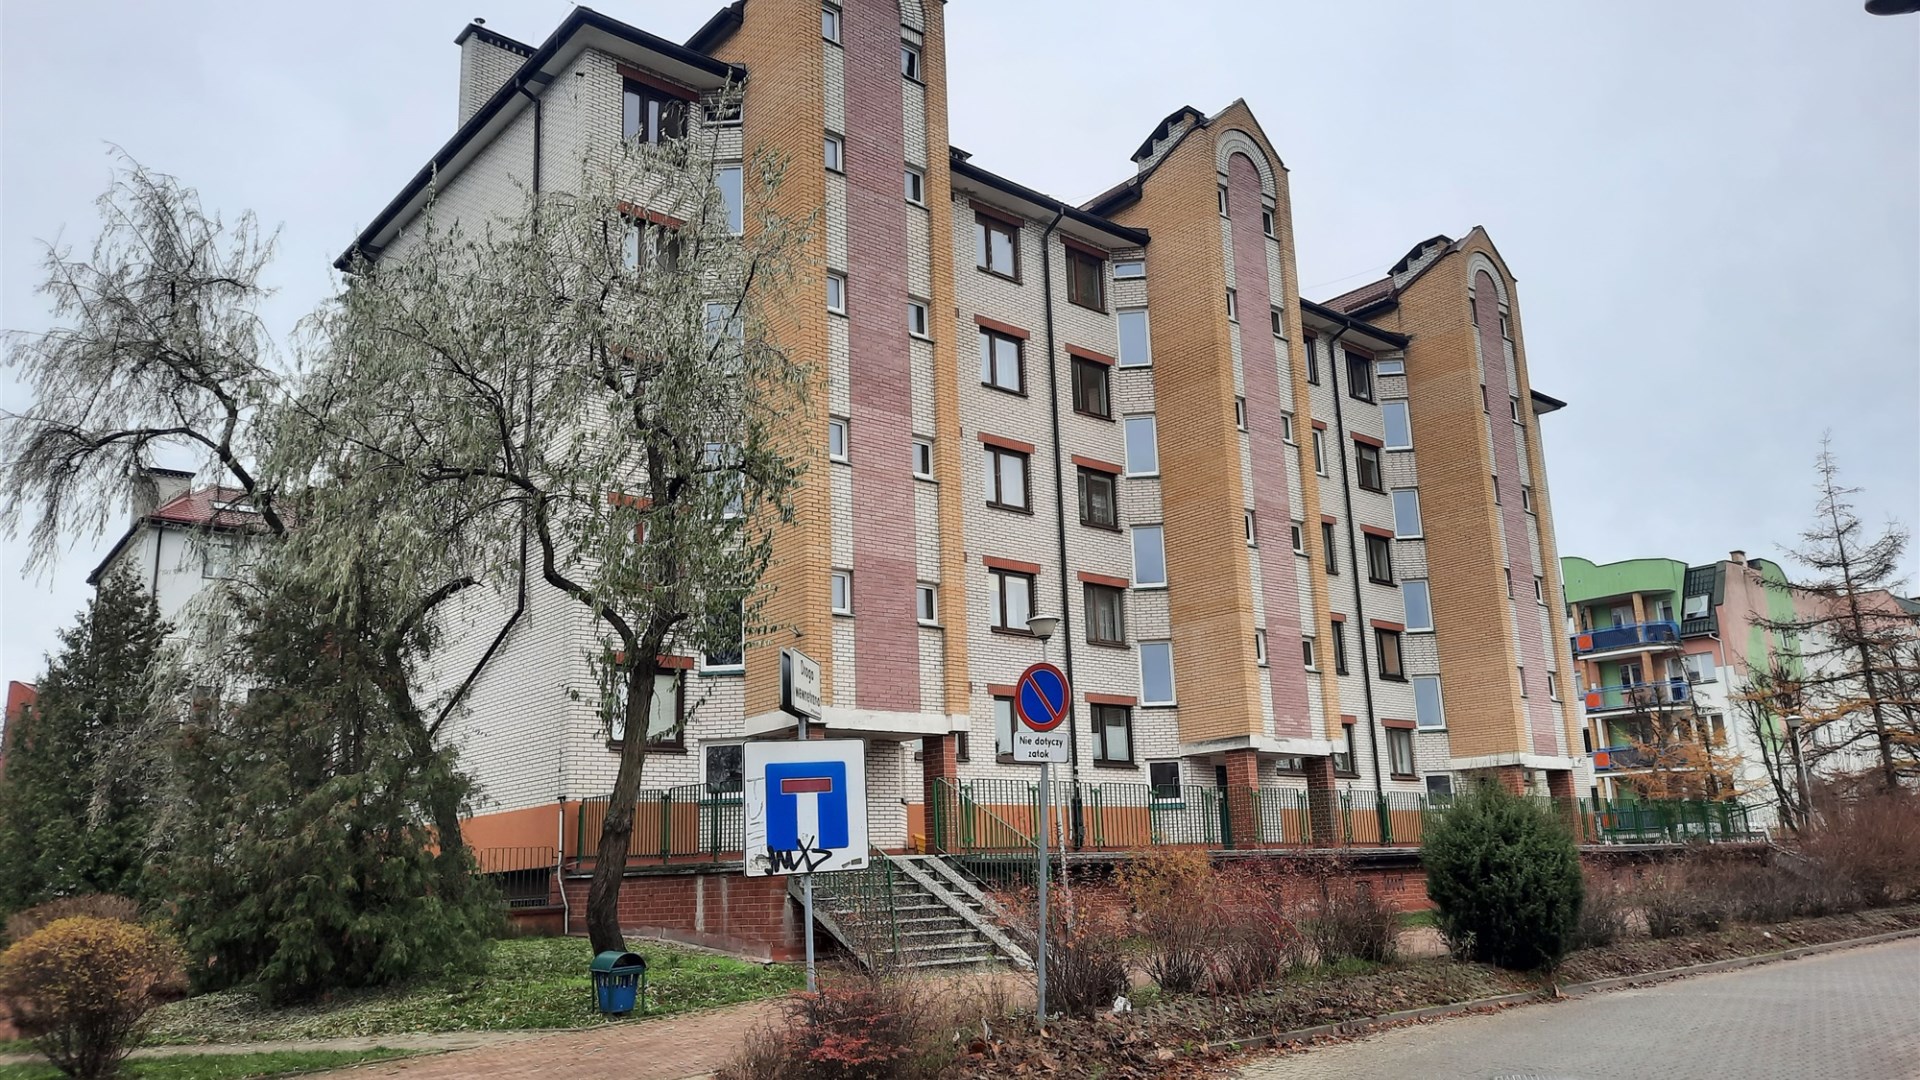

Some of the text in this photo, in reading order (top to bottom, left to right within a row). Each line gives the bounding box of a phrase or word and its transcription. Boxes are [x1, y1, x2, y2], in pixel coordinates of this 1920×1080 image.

[1019, 736, 1063, 748] Nie dotyczy
[1028, 749, 1049, 758] zatok
